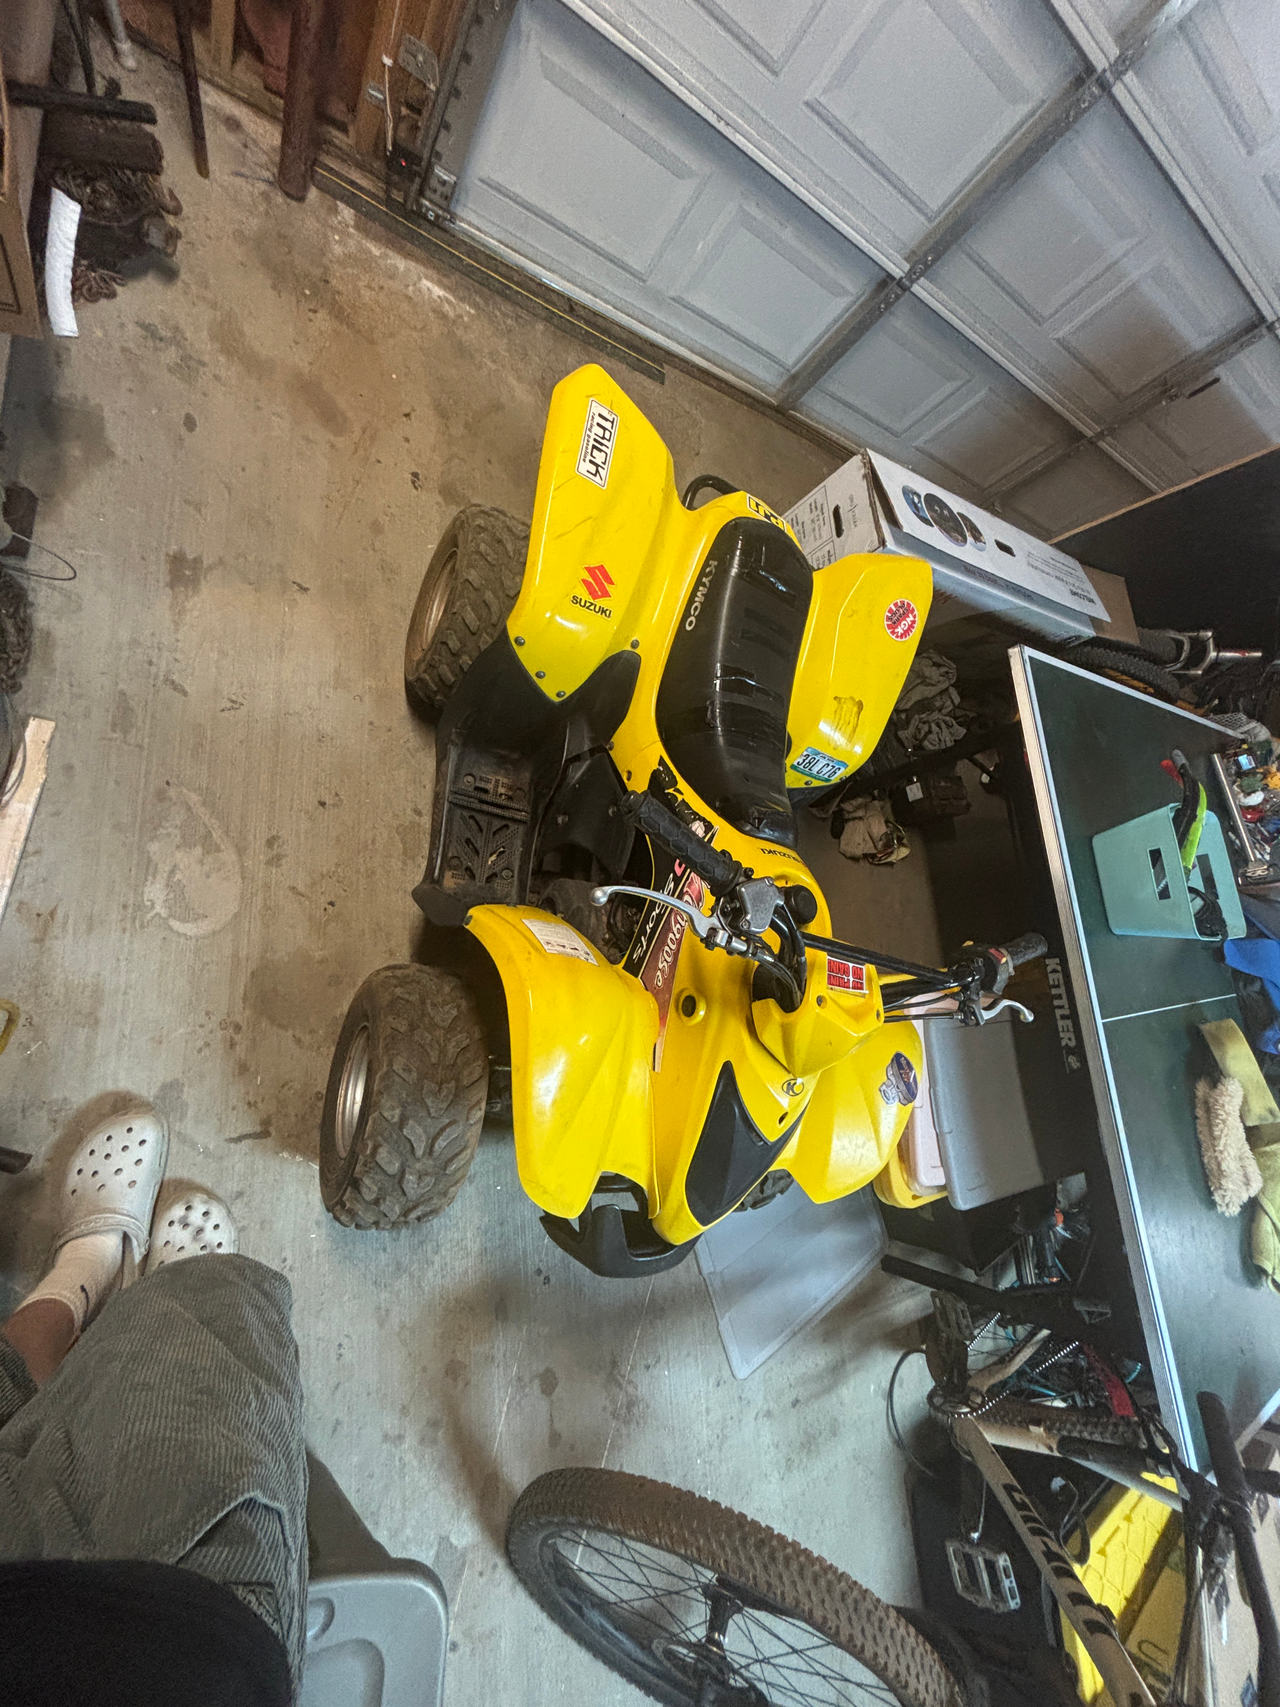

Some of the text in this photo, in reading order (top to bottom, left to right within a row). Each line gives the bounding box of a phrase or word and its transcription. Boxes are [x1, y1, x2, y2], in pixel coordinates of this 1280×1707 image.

[586, 412, 615, 482] TRICK
[571, 595, 612, 619] SUZUKI
[685, 560, 718, 631] KYMCO
[895, 613, 915, 636] NGK
[851, 964, 865, 981] NO
[1045, 957, 1077, 1047] KETTLER
